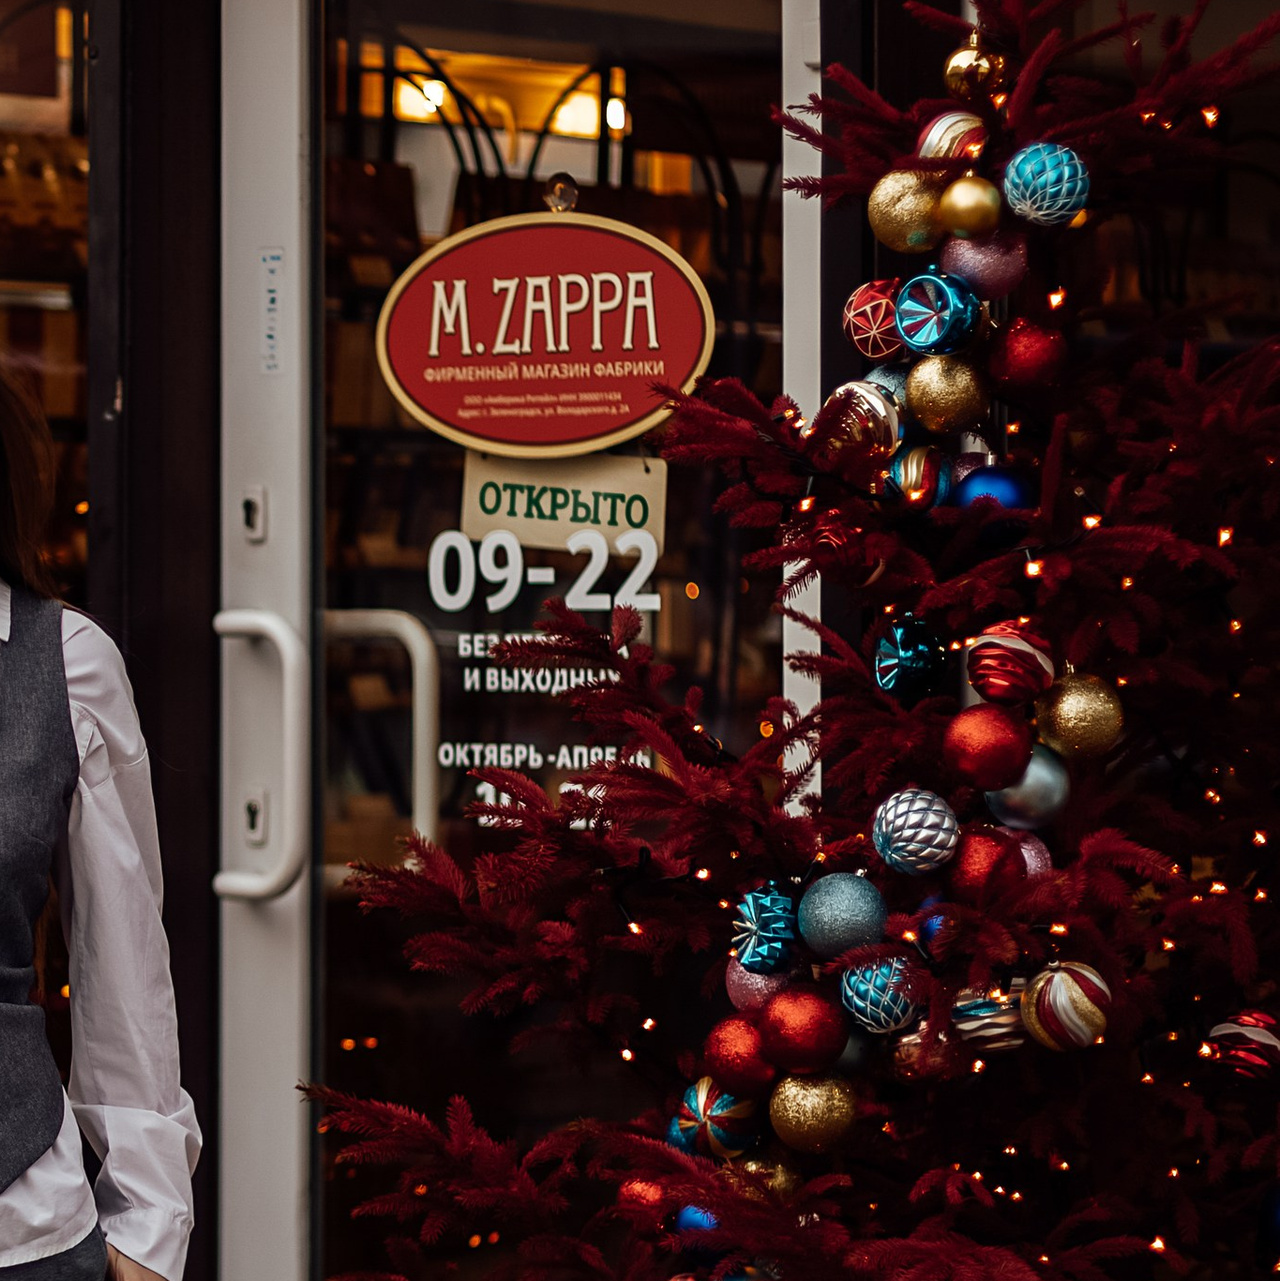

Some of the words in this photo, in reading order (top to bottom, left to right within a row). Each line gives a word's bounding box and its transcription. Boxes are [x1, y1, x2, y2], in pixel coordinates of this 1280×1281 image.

[423, 361, 519, 383] ФИРМЕННЫЙ
[522, 362, 591, 381] МАГАЗИН
[593, 360, 665, 379] ФАБРИКИ
[478, 481, 650, 529] ОТКРЫТО
[428, 529, 661, 613] 09-22
[463, 668, 481, 692] И
[438, 742, 543, 768] ОКТЯБРЬ
